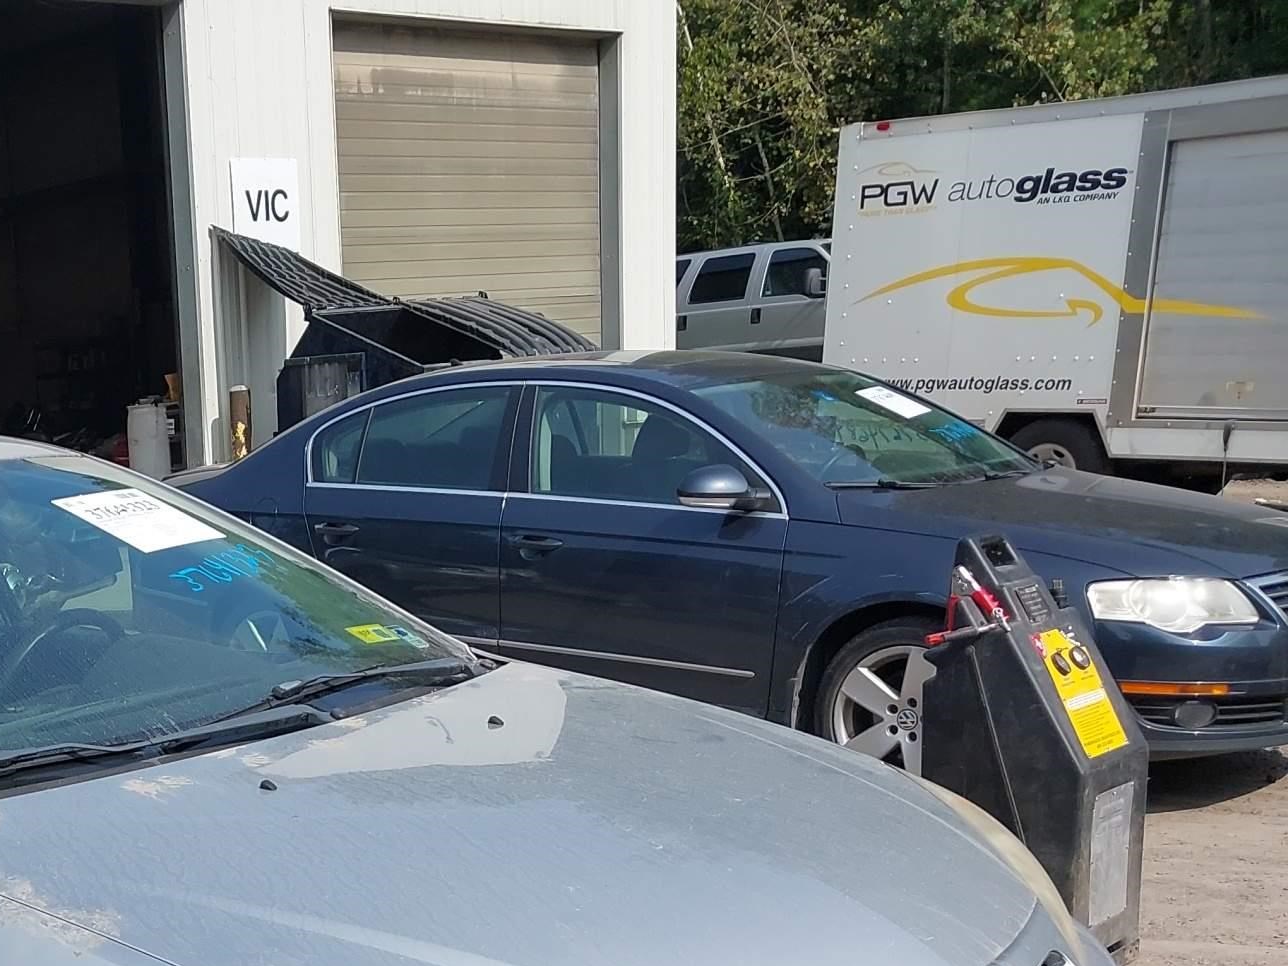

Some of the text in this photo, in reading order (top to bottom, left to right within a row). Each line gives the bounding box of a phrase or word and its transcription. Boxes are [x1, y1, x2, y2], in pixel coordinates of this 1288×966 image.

[245, 188, 290, 223] VIC
[860, 167, 1128, 210] PGW autoglass
[1037, 196, 1051, 205] AN
[1073, 191, 1119, 202] COMPANY
